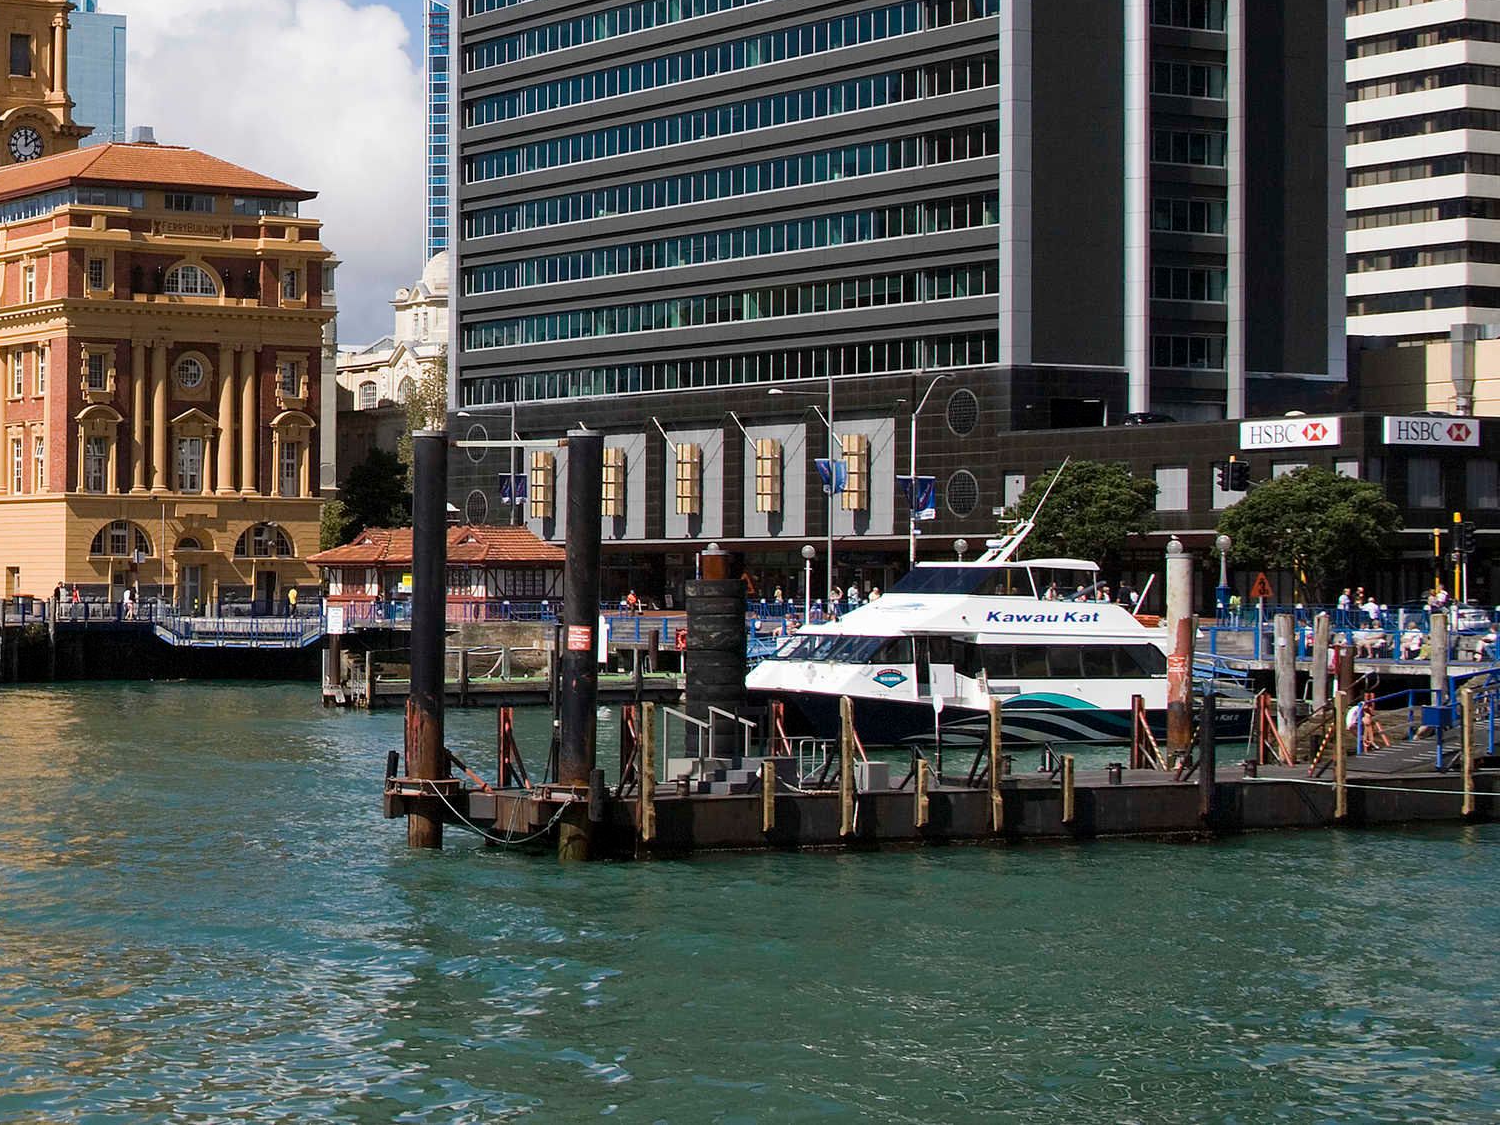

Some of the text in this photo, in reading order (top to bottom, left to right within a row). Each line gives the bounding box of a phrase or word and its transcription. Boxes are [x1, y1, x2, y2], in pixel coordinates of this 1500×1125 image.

[1250, 424, 1298, 444] HSBC
[1396, 420, 1443, 442] HSBC
[986, 611, 1100, 623] Kawau Kat
